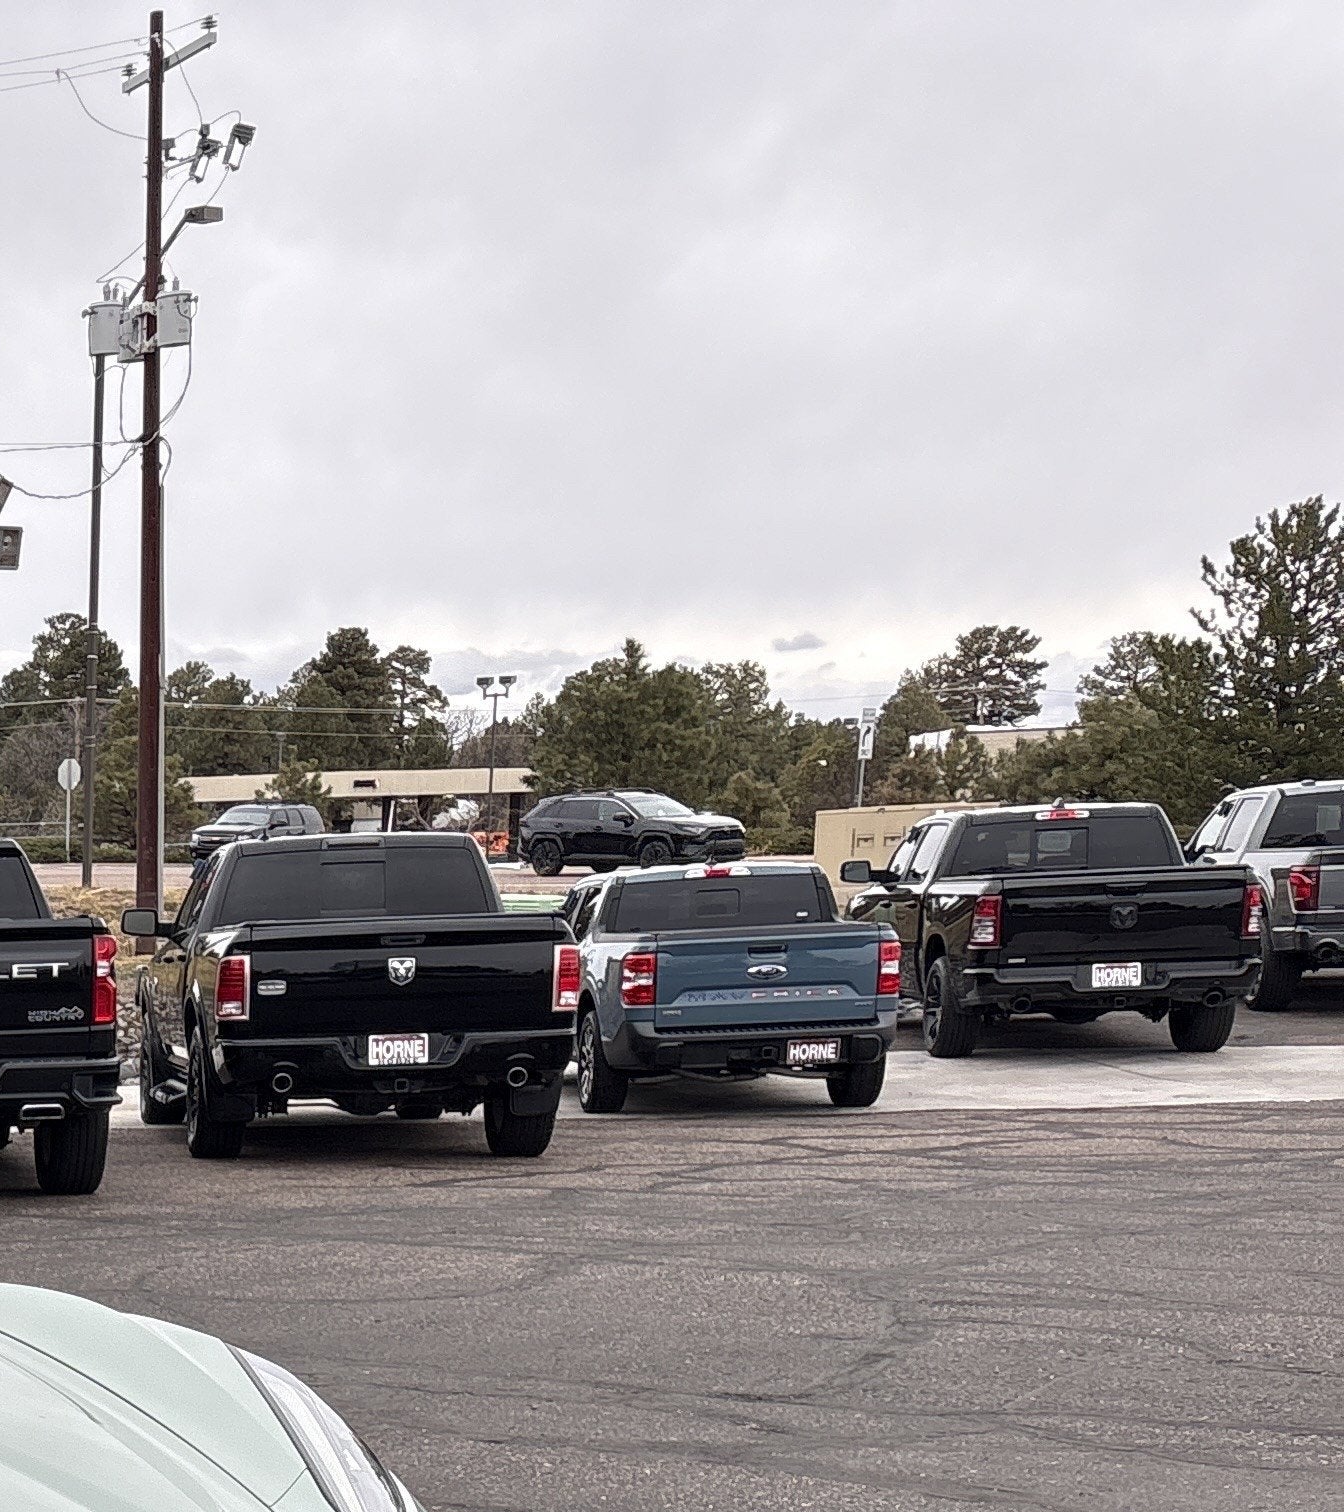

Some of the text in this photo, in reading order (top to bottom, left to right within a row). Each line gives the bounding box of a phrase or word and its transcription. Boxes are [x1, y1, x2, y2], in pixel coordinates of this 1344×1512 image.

[1096, 968, 1137, 982] HORNE
[372, 1039, 424, 1060] HORNE
[789, 1042, 836, 1060] HORNE
